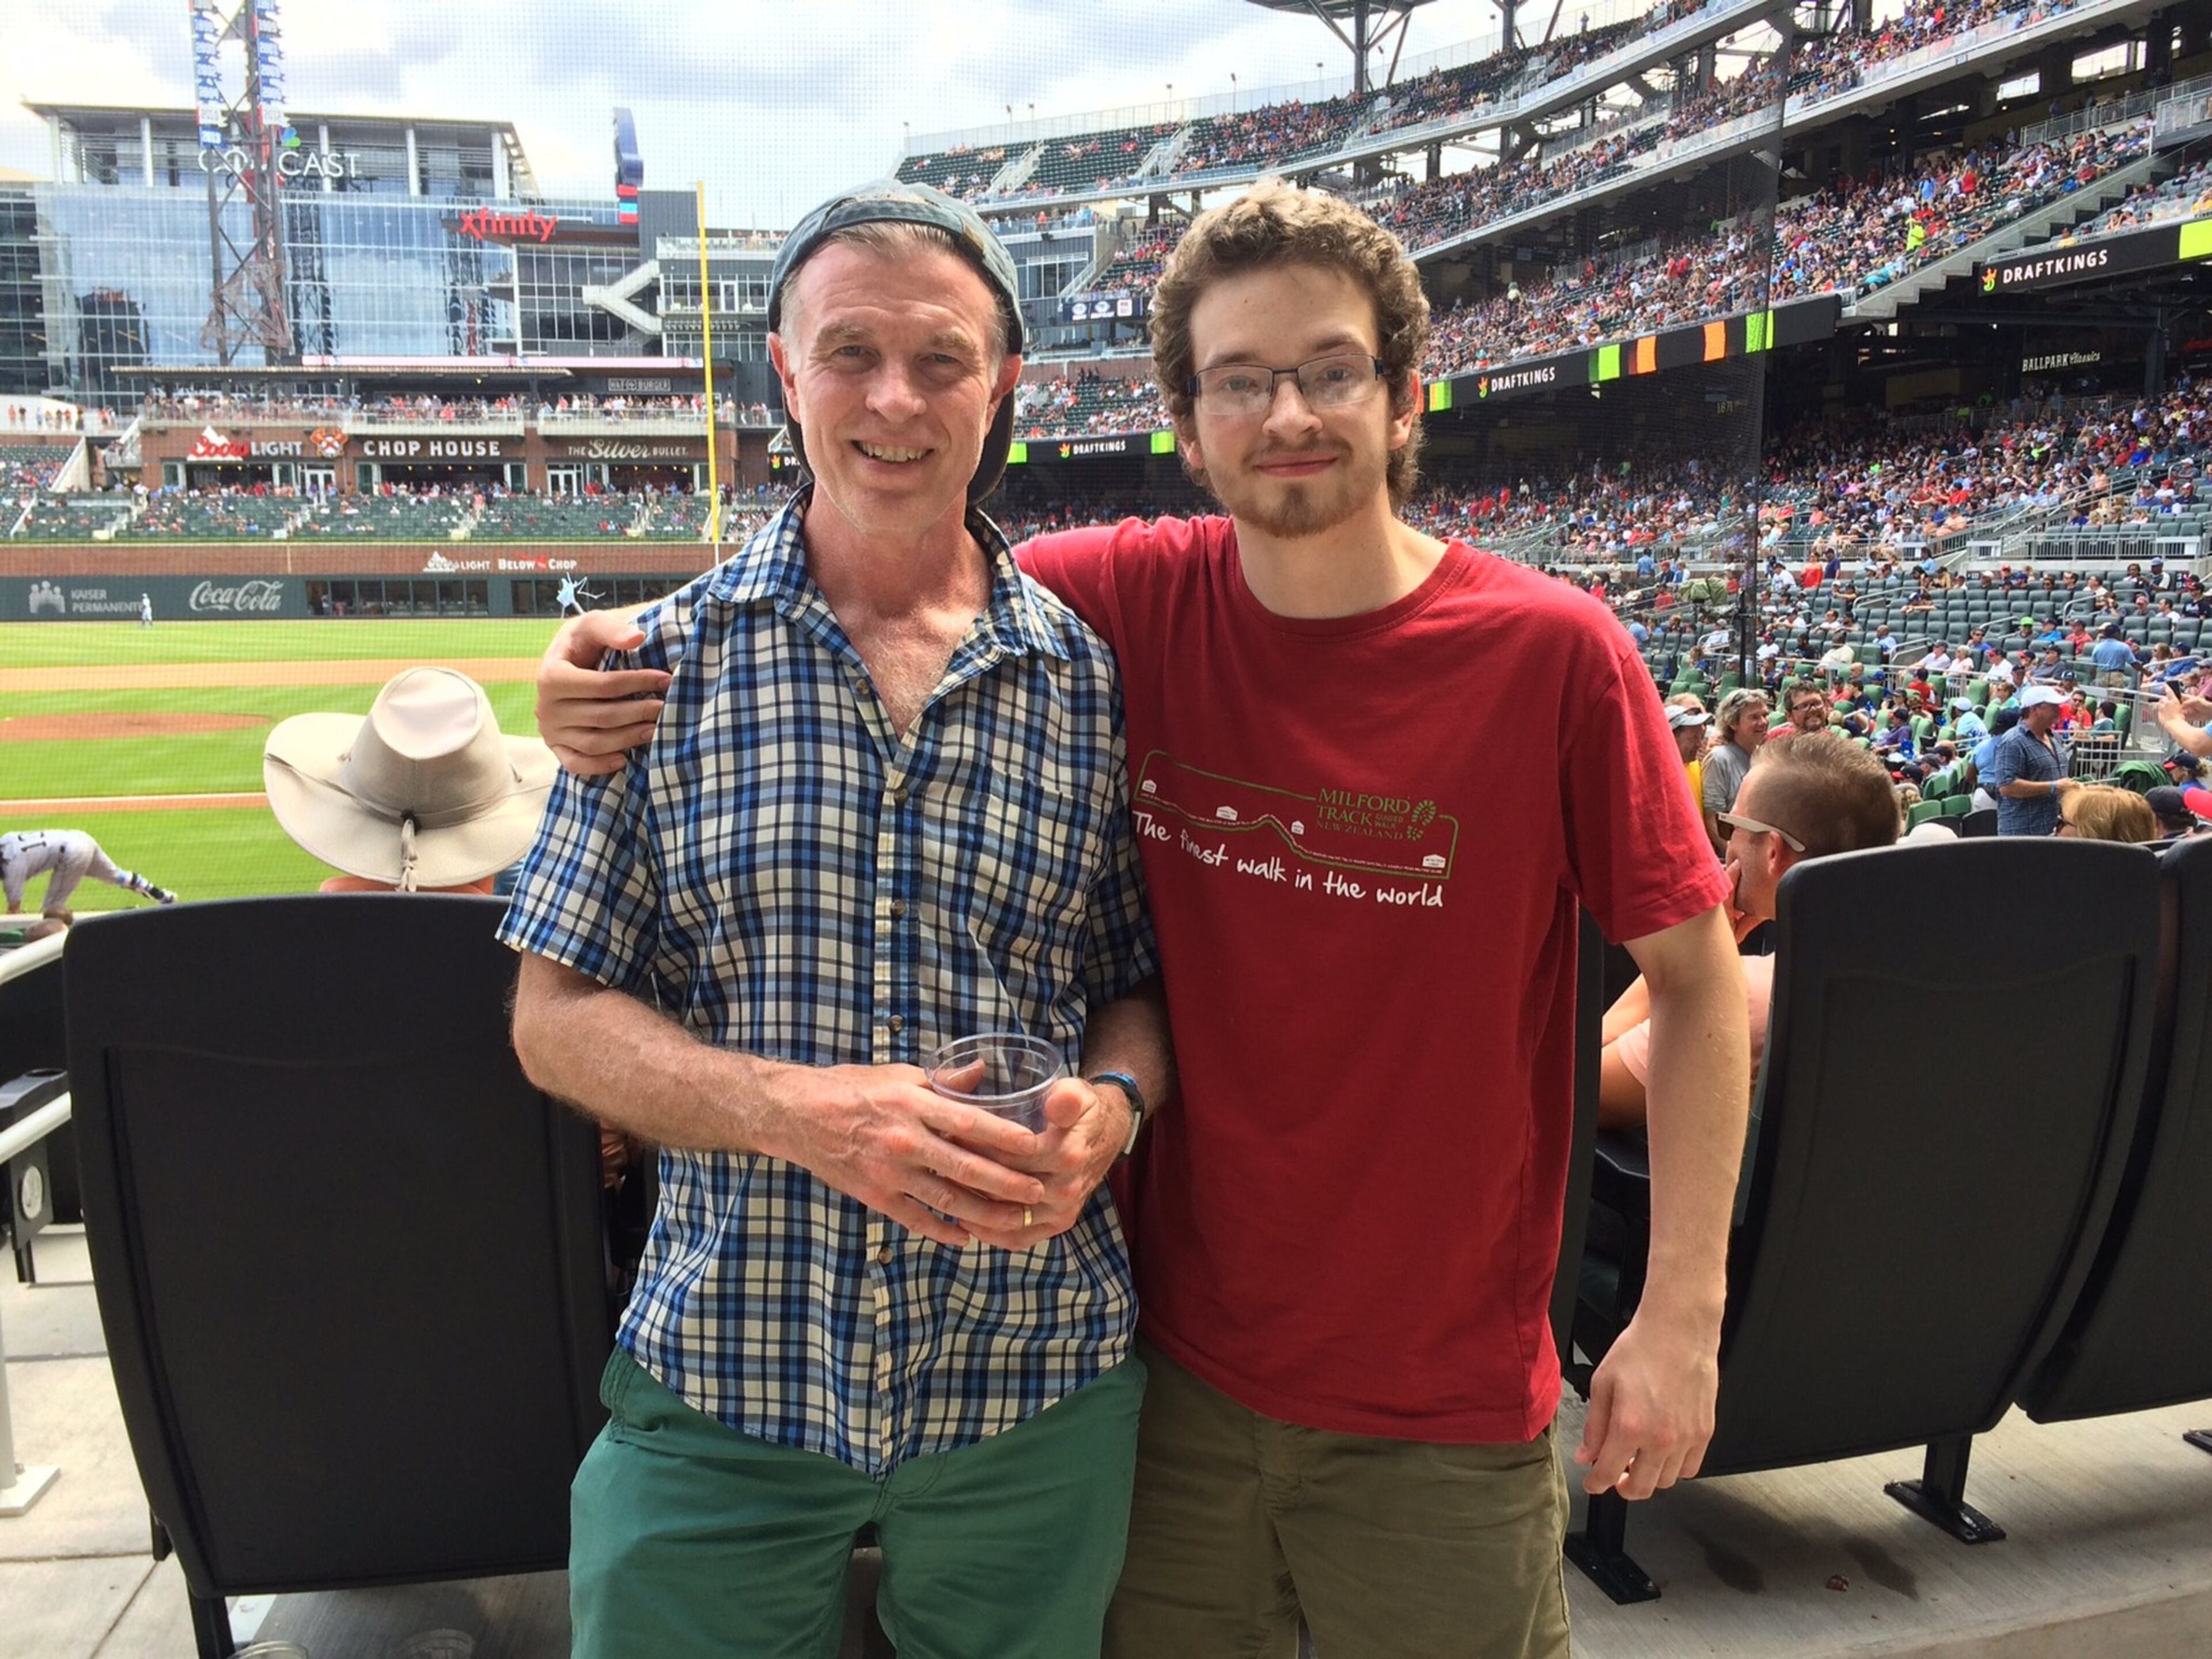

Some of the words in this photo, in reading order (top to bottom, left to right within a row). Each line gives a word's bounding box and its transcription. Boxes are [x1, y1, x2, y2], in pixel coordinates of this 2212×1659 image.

[460, 207, 559, 245] xfinity
[2003, 249, 2108, 284] DRAFTKINGS
[2021, 353, 2069, 373] BALLPARK
[1491, 366, 1556, 392] DRAFTKINGS
[190, 435, 250, 457] Coors
[251, 441, 302, 456] LIGHT
[363, 440, 421, 457] CHOP
[429, 440, 501, 457] HOUSE
[567, 446, 586, 456] THE
[588, 438, 650, 459] Silver
[653, 446, 687, 457] BULLET
[1073, 440, 1126, 455] DRAFTKINGS
[461, 560, 491, 570] LIGHT
[70, 589, 107, 600] KAISER
[189, 579, 285, 612] Coca-Cola
[1319, 787, 1411, 815] MILFORD
[1317, 805, 1373, 827] TRACK
[1316, 820, 1340, 832] NEW
[1345, 825, 1404, 840] ZEALAND
[1131, 810, 1172, 842] The
[1180, 829, 1229, 867] finest
[1237, 856, 1287, 882] walk
[1294, 869, 1313, 891] in
[1322, 870, 1367, 899] the
[1376, 882, 1444, 908] world
